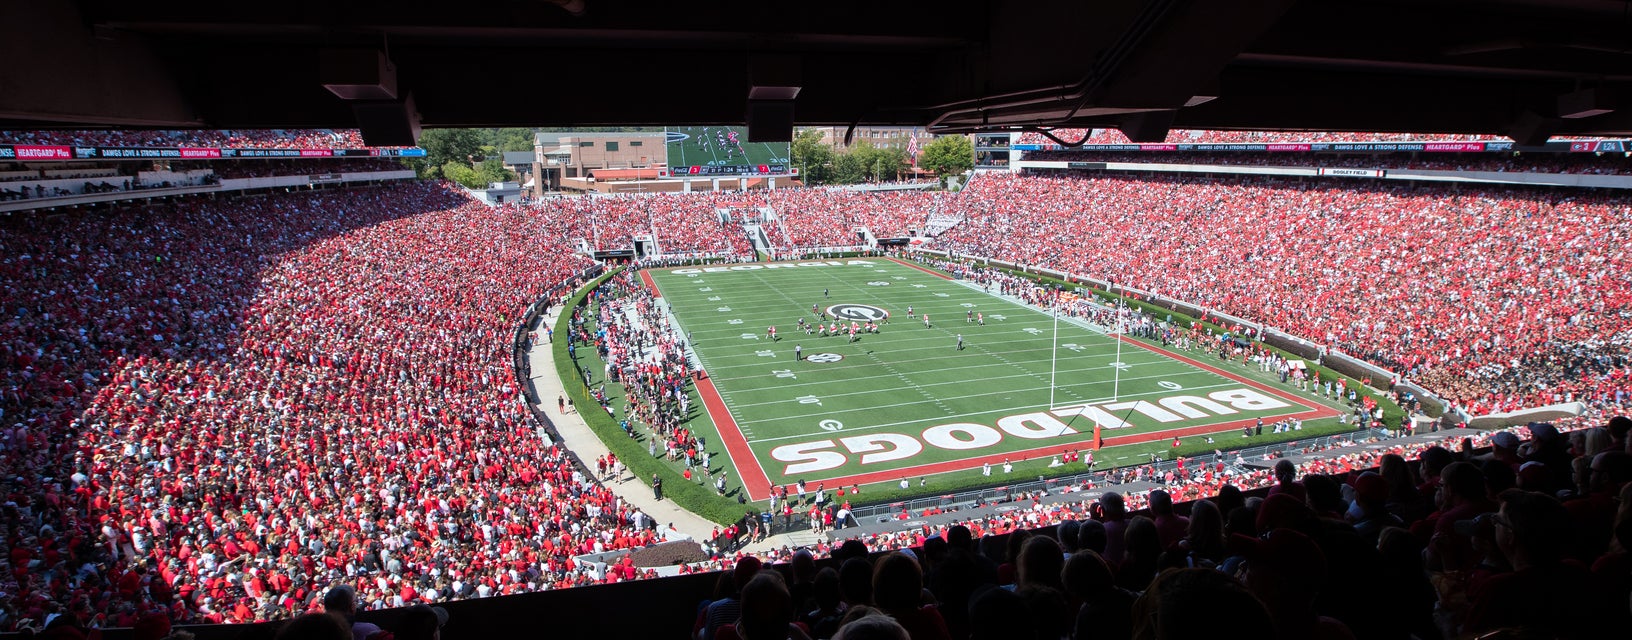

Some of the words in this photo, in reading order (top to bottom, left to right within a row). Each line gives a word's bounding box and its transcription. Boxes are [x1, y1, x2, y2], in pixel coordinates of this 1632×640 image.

[671, 261, 877, 274] GEORGIA
[819, 418, 843, 430] G
[771, 389, 1290, 475] BULLDOGS
